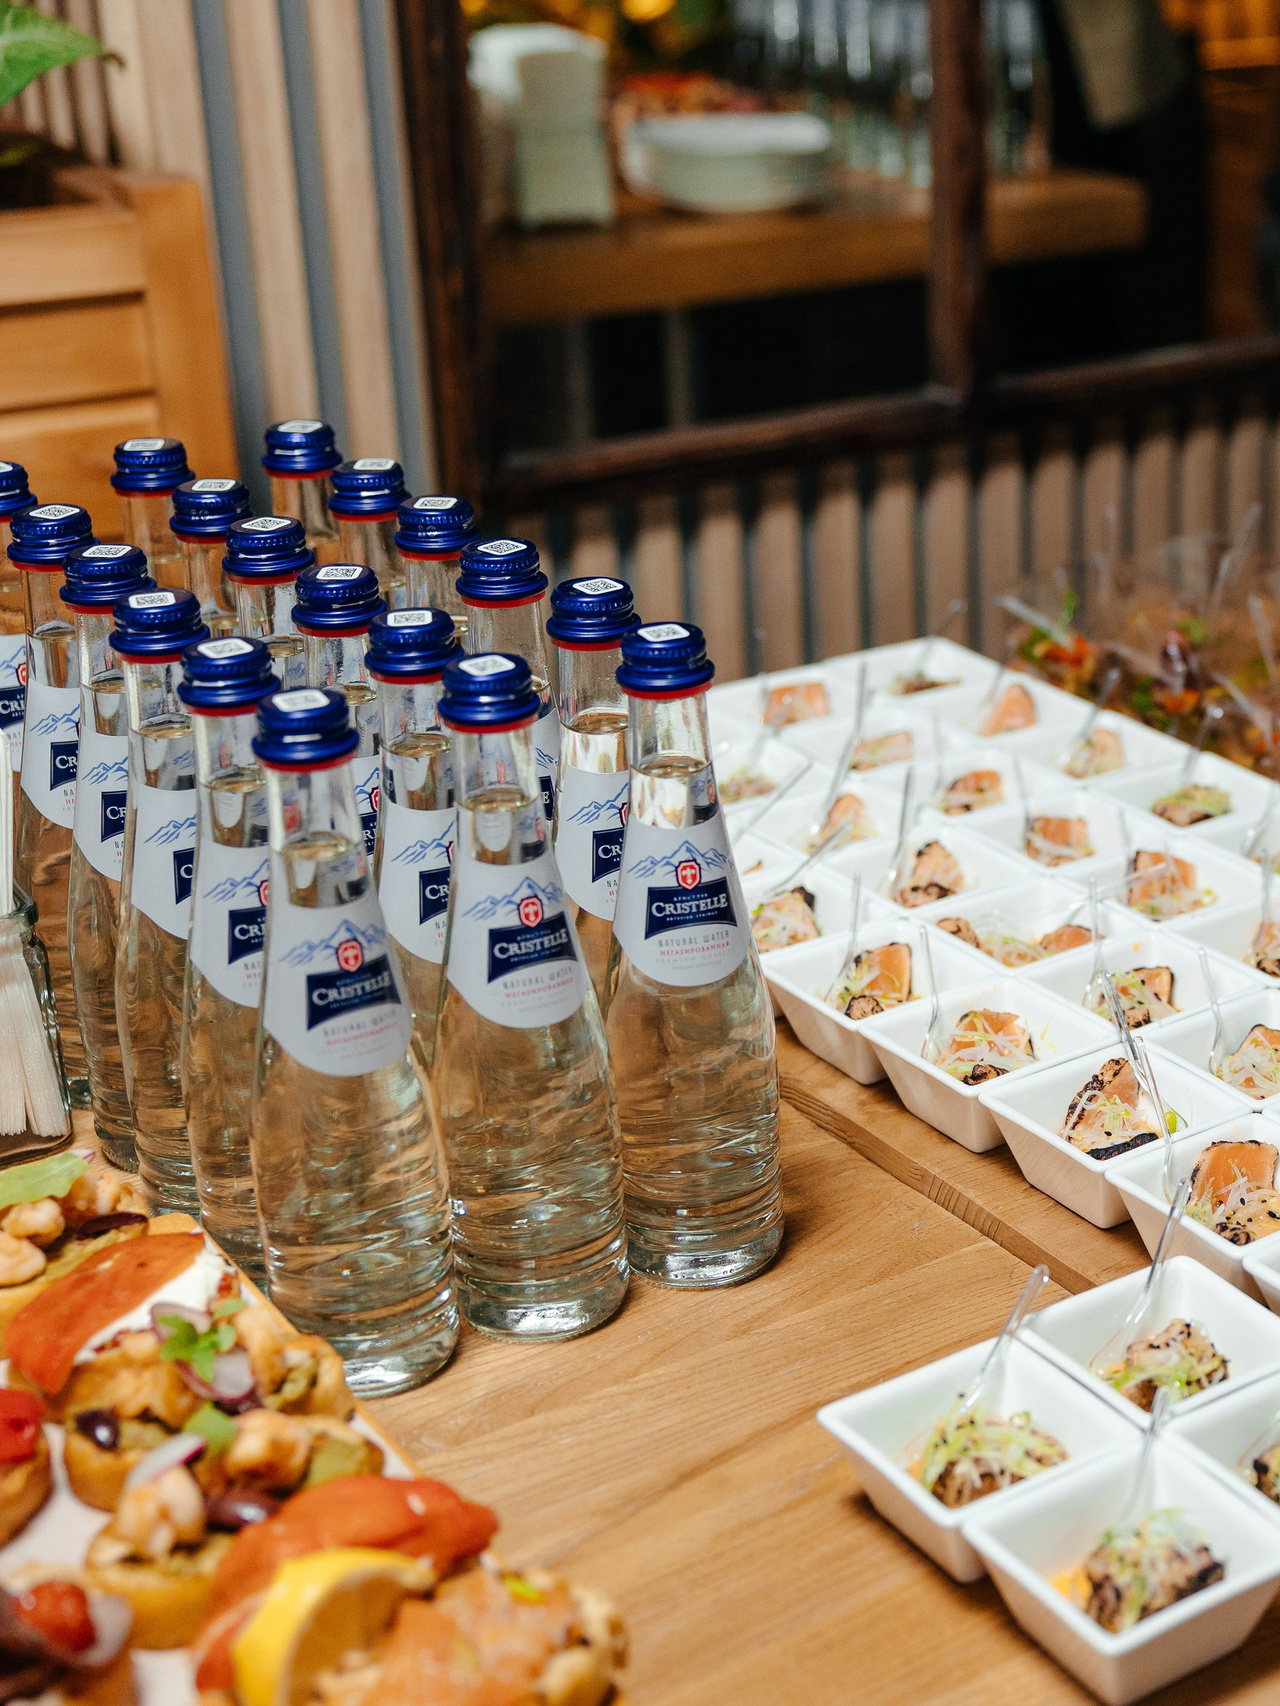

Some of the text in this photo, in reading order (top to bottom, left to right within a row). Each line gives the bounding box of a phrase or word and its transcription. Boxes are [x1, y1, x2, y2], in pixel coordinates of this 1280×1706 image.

[651, 893, 728, 918] CRISTELLE
[493, 928, 569, 959] CRISTELLE
[658, 930, 730, 948] NATURAL WATER
